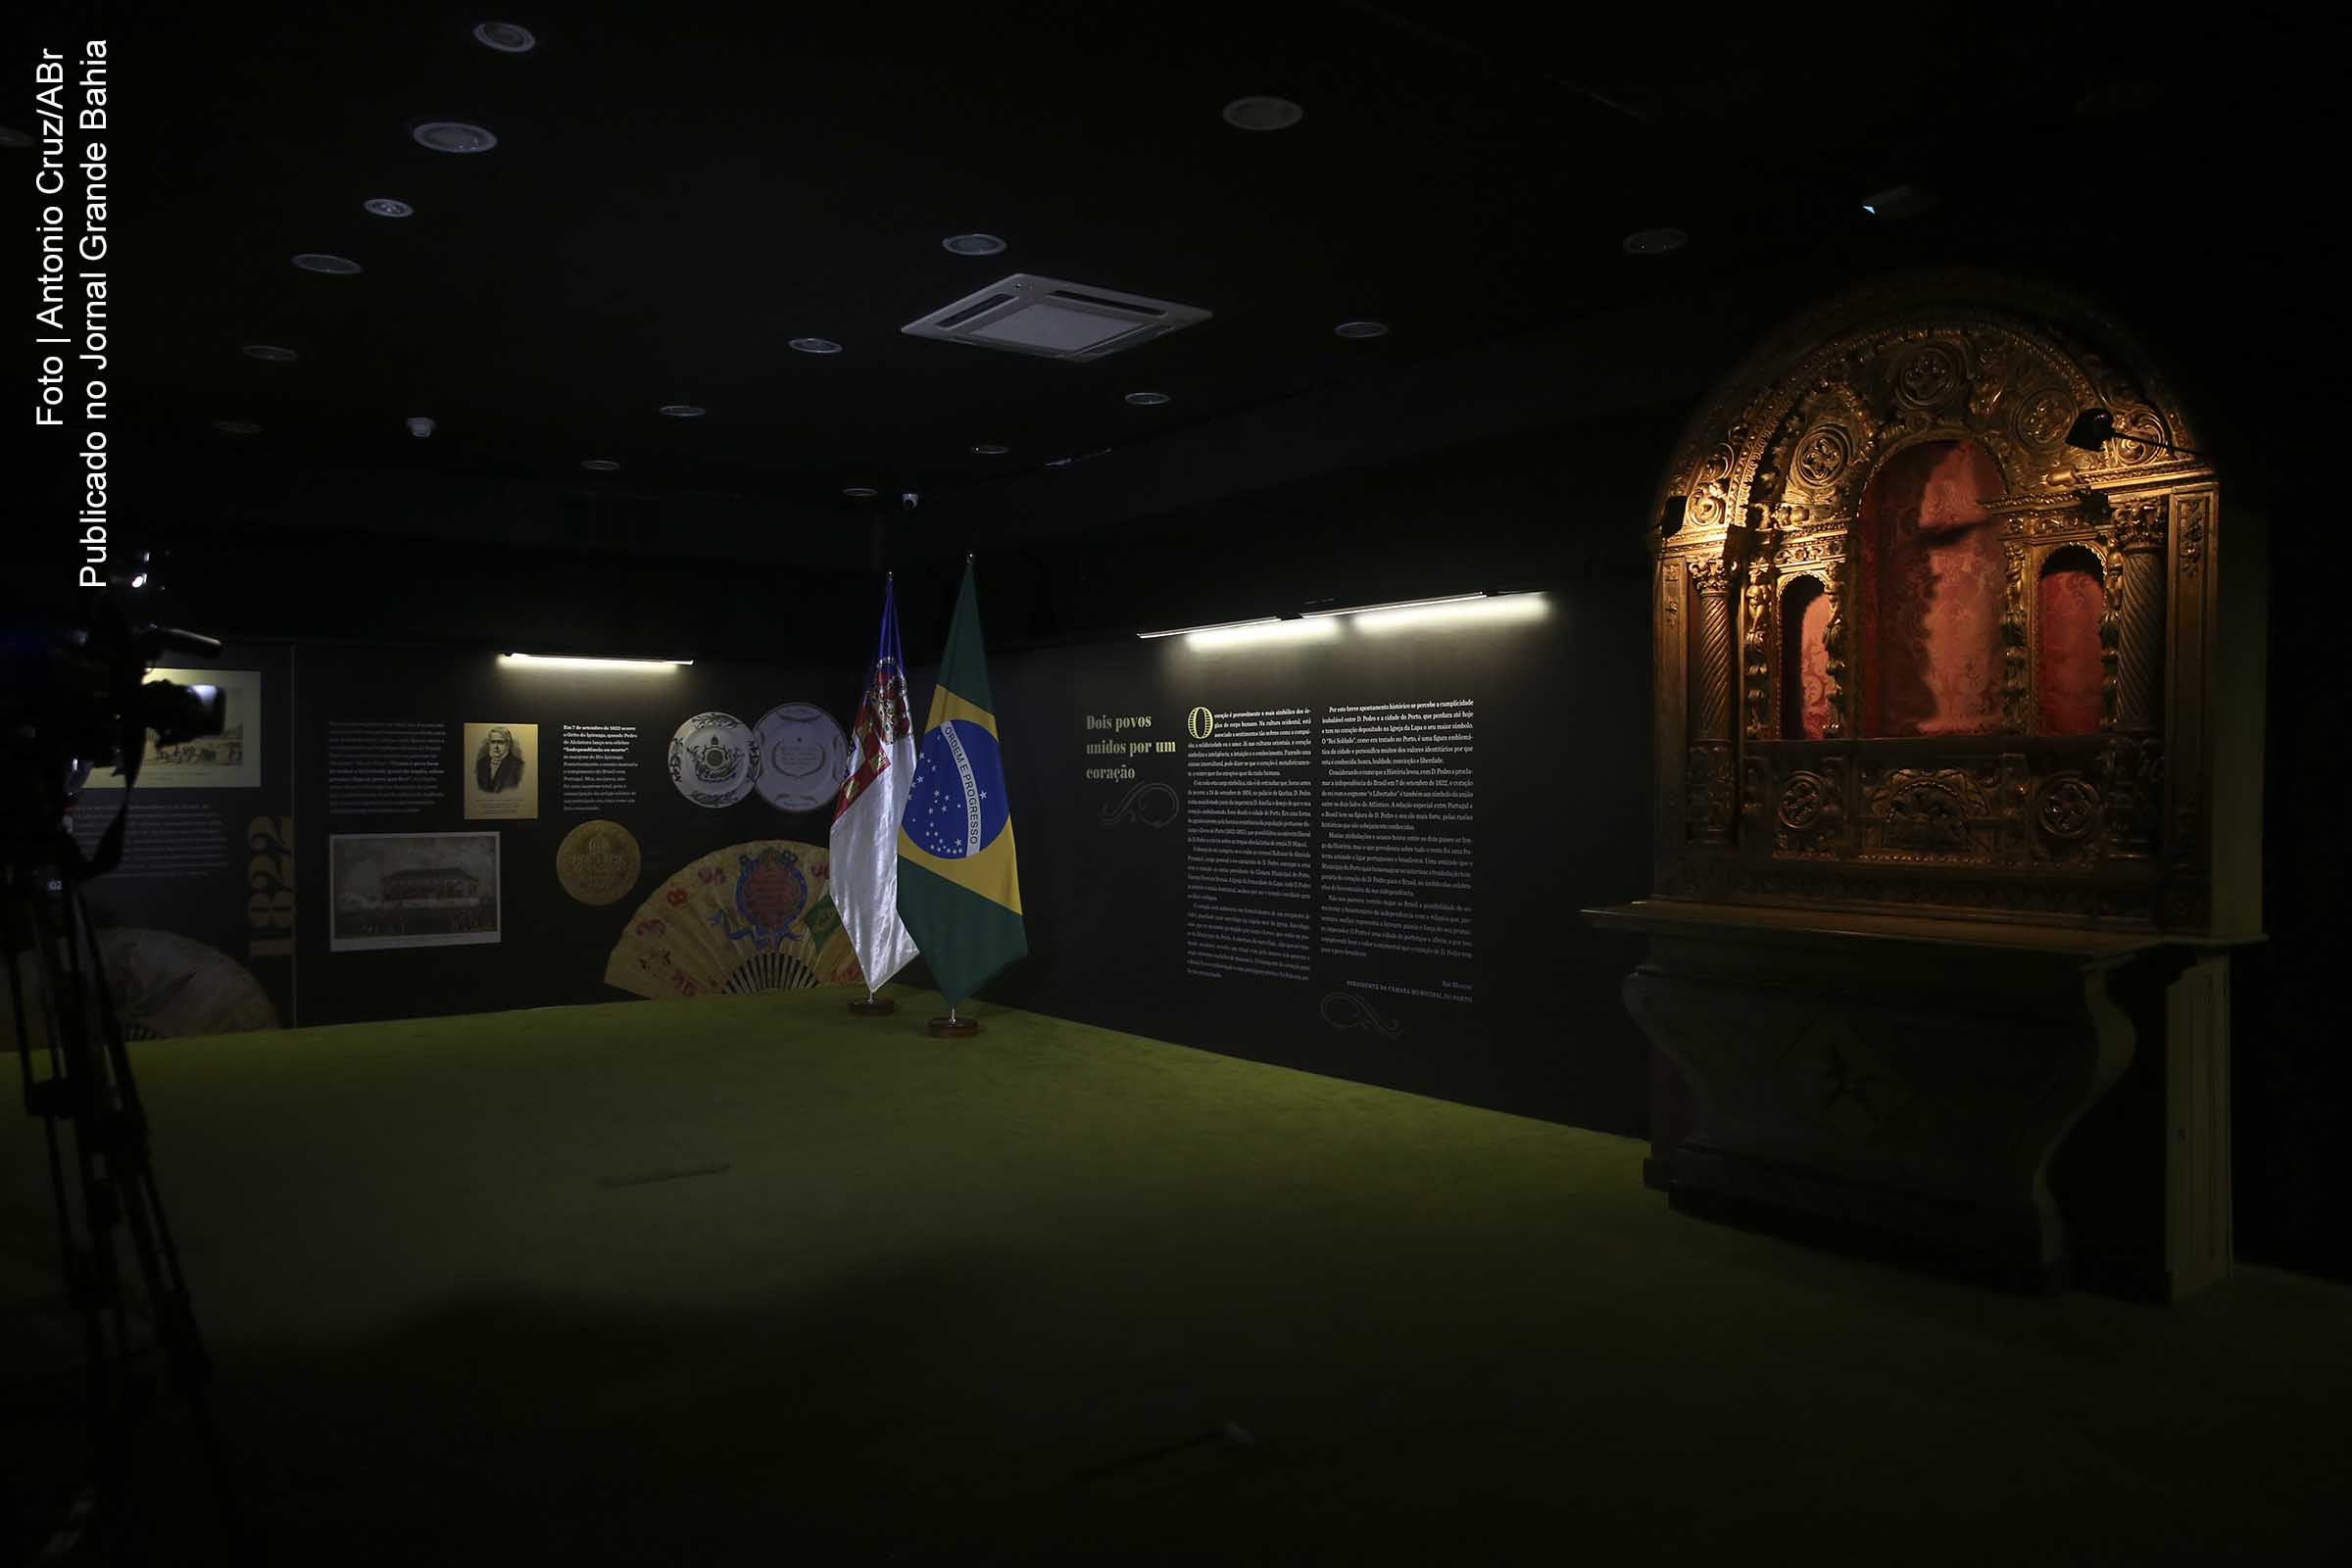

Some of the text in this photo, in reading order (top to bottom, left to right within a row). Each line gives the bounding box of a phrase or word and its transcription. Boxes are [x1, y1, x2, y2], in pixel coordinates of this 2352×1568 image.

[1417, 701, 1436, 710] percebe
[1086, 714, 1152, 733] Dois povos
[1086, 739, 1127, 756] unidos
[1129, 741, 1152, 758] por
[1155, 740, 1177, 754] um
[1086, 764, 1136, 784] coração
[945, 726, 979, 845] ORDEM E PROGRESSO
[249, 814, 296, 957] 1822
